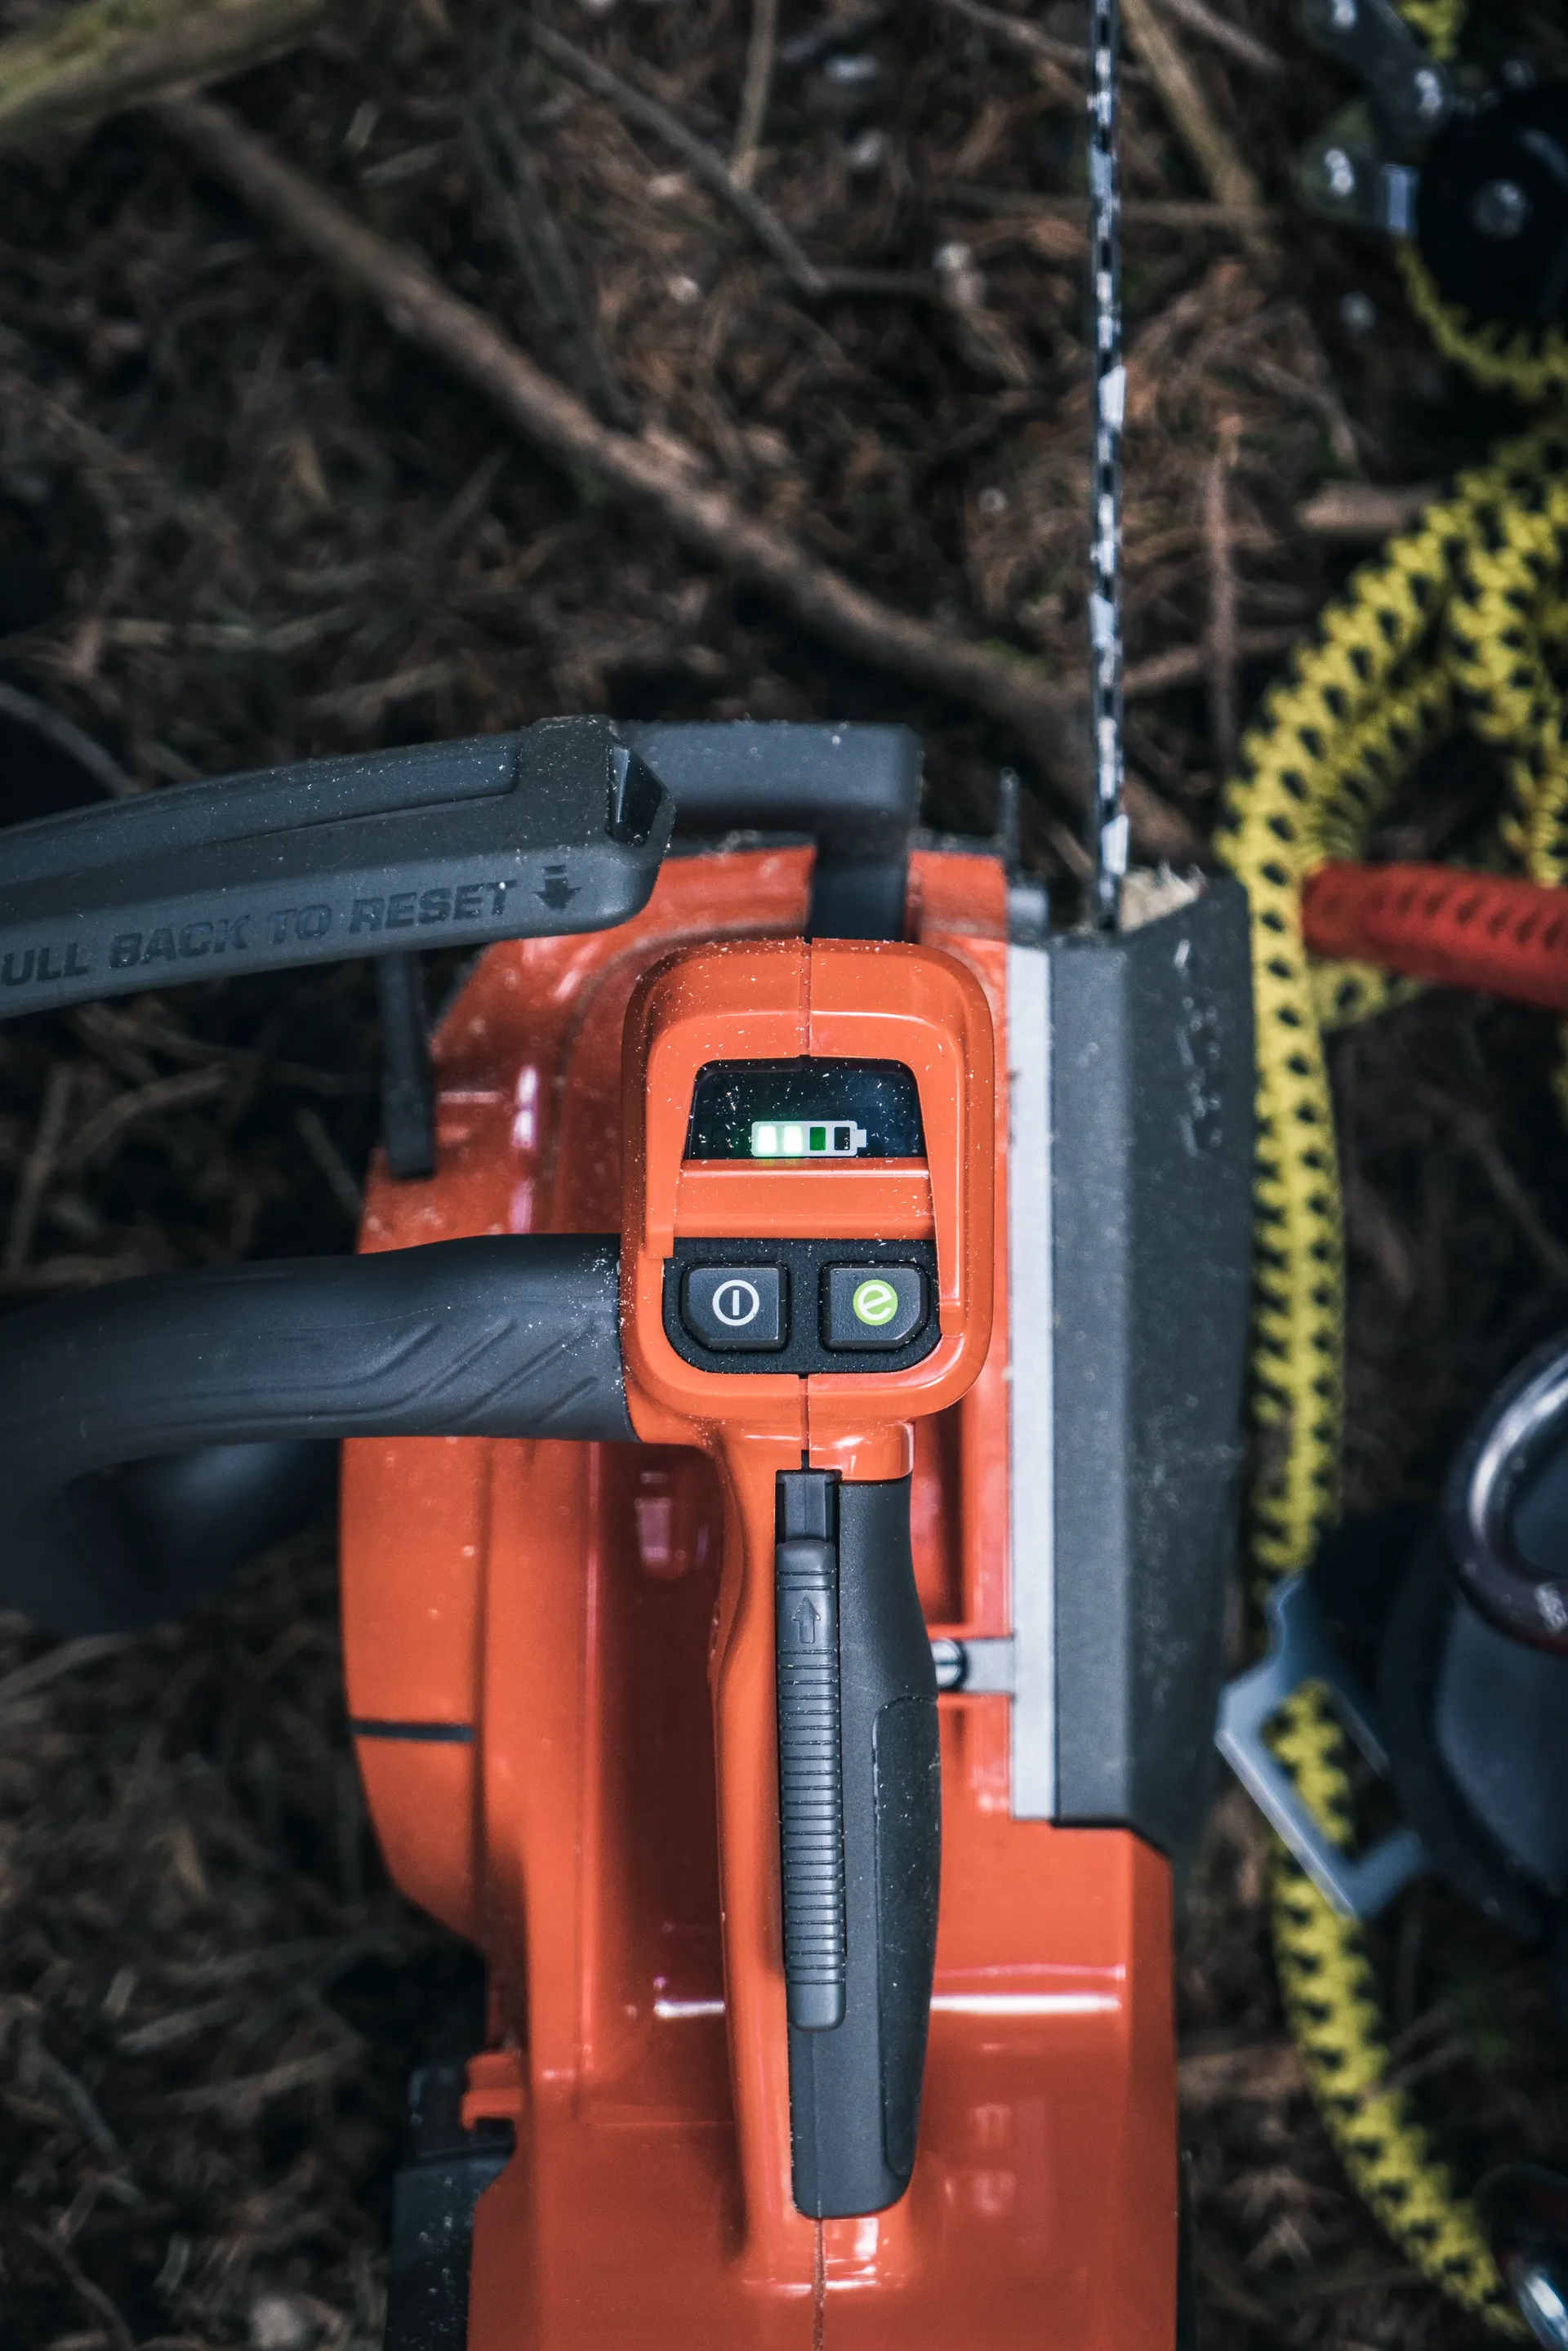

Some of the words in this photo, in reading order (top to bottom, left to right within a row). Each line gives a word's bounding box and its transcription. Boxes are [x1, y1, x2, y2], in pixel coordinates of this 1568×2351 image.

[0, 942, 89, 986] ULL
[109, 915, 251, 969] BACK
[268, 904, 332, 945] TO
[349, 879, 518, 935] RESET
